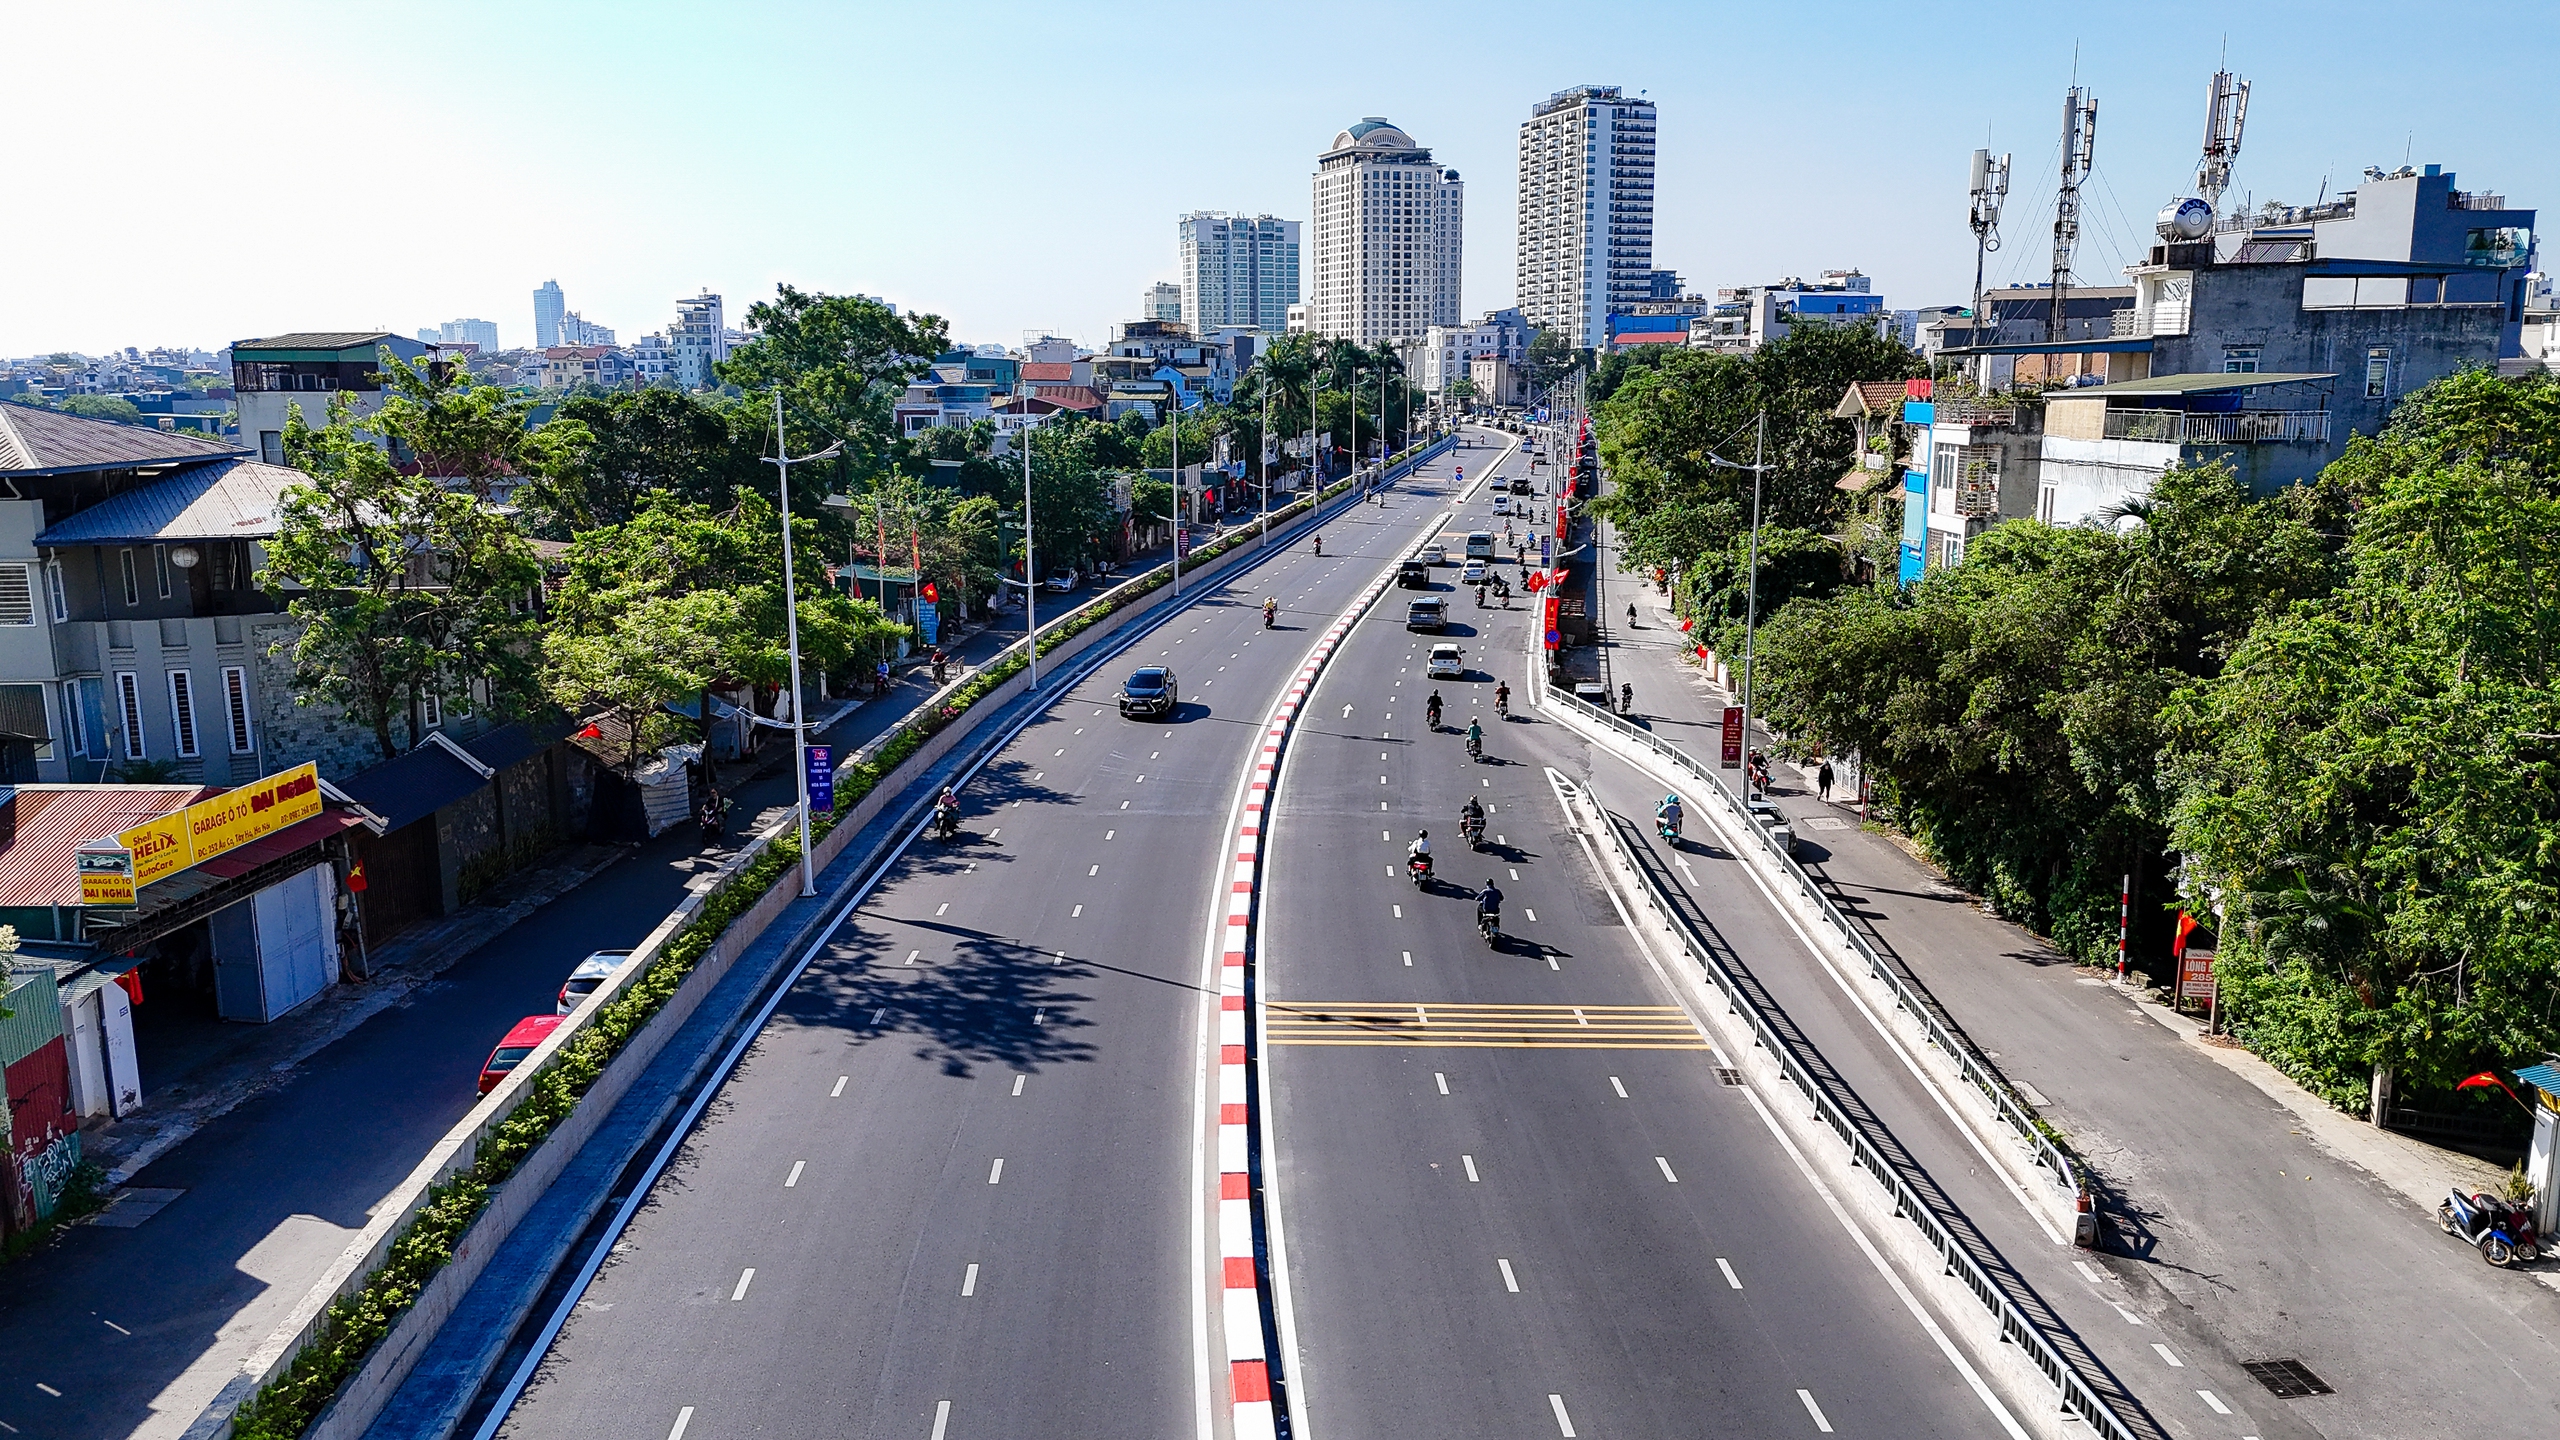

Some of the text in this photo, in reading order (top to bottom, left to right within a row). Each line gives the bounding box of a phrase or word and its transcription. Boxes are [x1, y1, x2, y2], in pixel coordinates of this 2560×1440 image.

[194, 812, 227, 836] GARAGE
[228, 806, 234, 822] Ô
[236, 801, 248, 818] TÔ
[251, 789, 275, 812] ĐẠI
[133, 831, 152, 846] Shell
[134, 834, 178, 860] HELIX
[138, 860, 174, 879] AutoCare
[84, 888, 99, 899] ĐẠI
